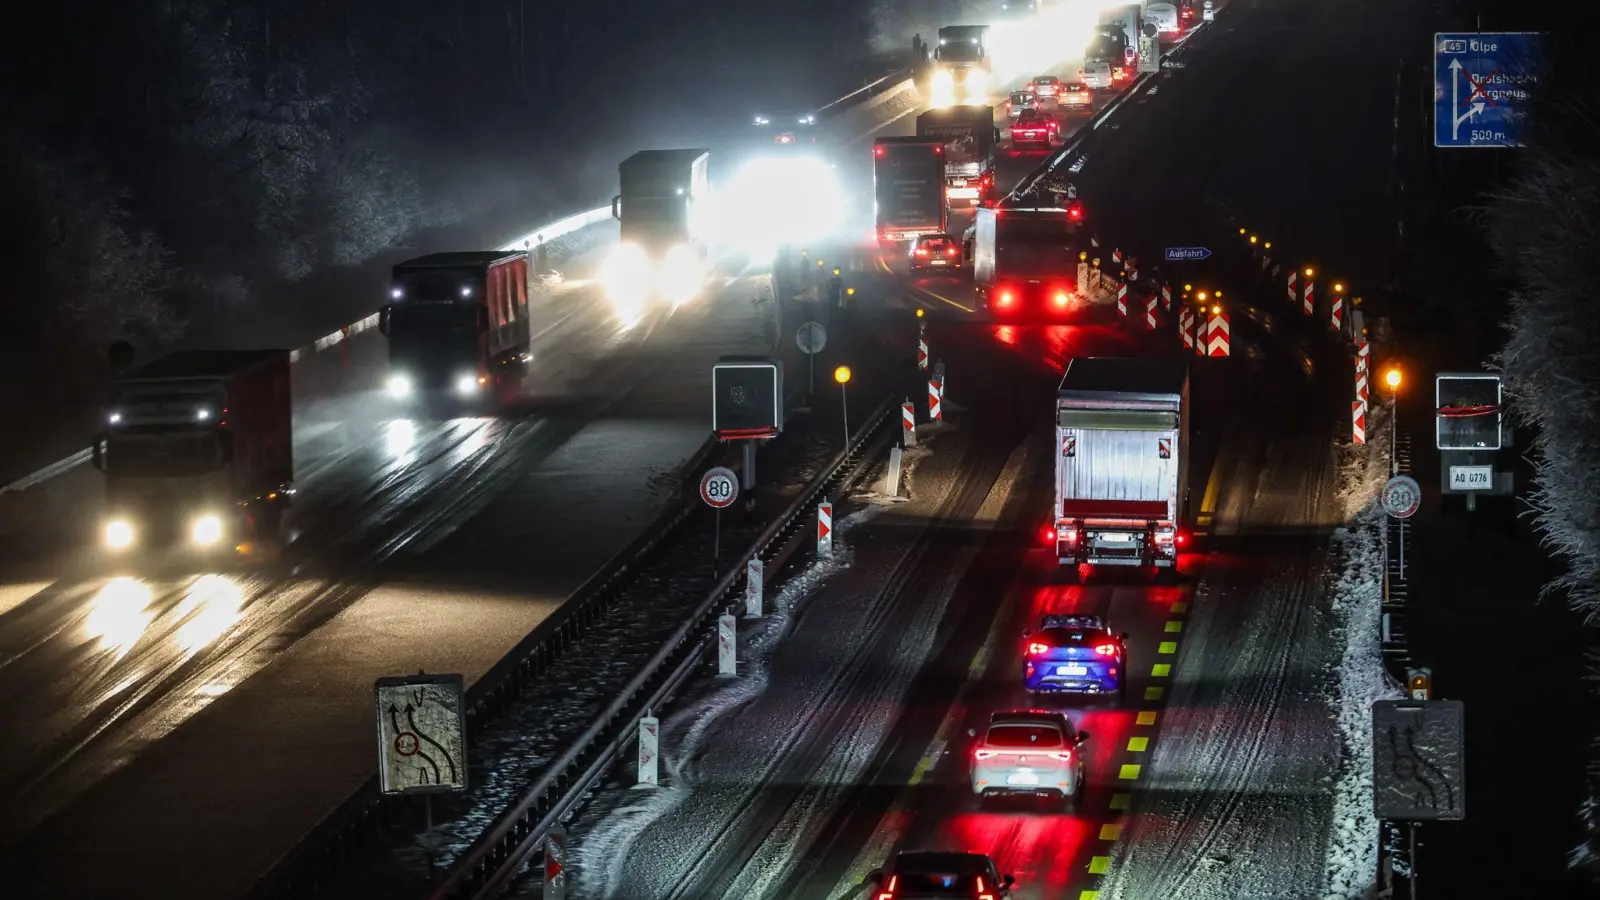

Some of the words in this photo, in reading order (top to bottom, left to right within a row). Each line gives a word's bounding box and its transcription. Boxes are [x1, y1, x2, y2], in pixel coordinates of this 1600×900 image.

[1449, 43, 1461, 51] 45
[1471, 41, 1498, 54] Olpe
[1471, 73, 1538, 85] Drolsh
[1471, 130, 1492, 141] 500
[1494, 132, 1506, 140] m
[1169, 250, 1203, 258] Ausfahrt
[1455, 473, 1466, 483] AQ
[709, 480, 730, 497] 80
